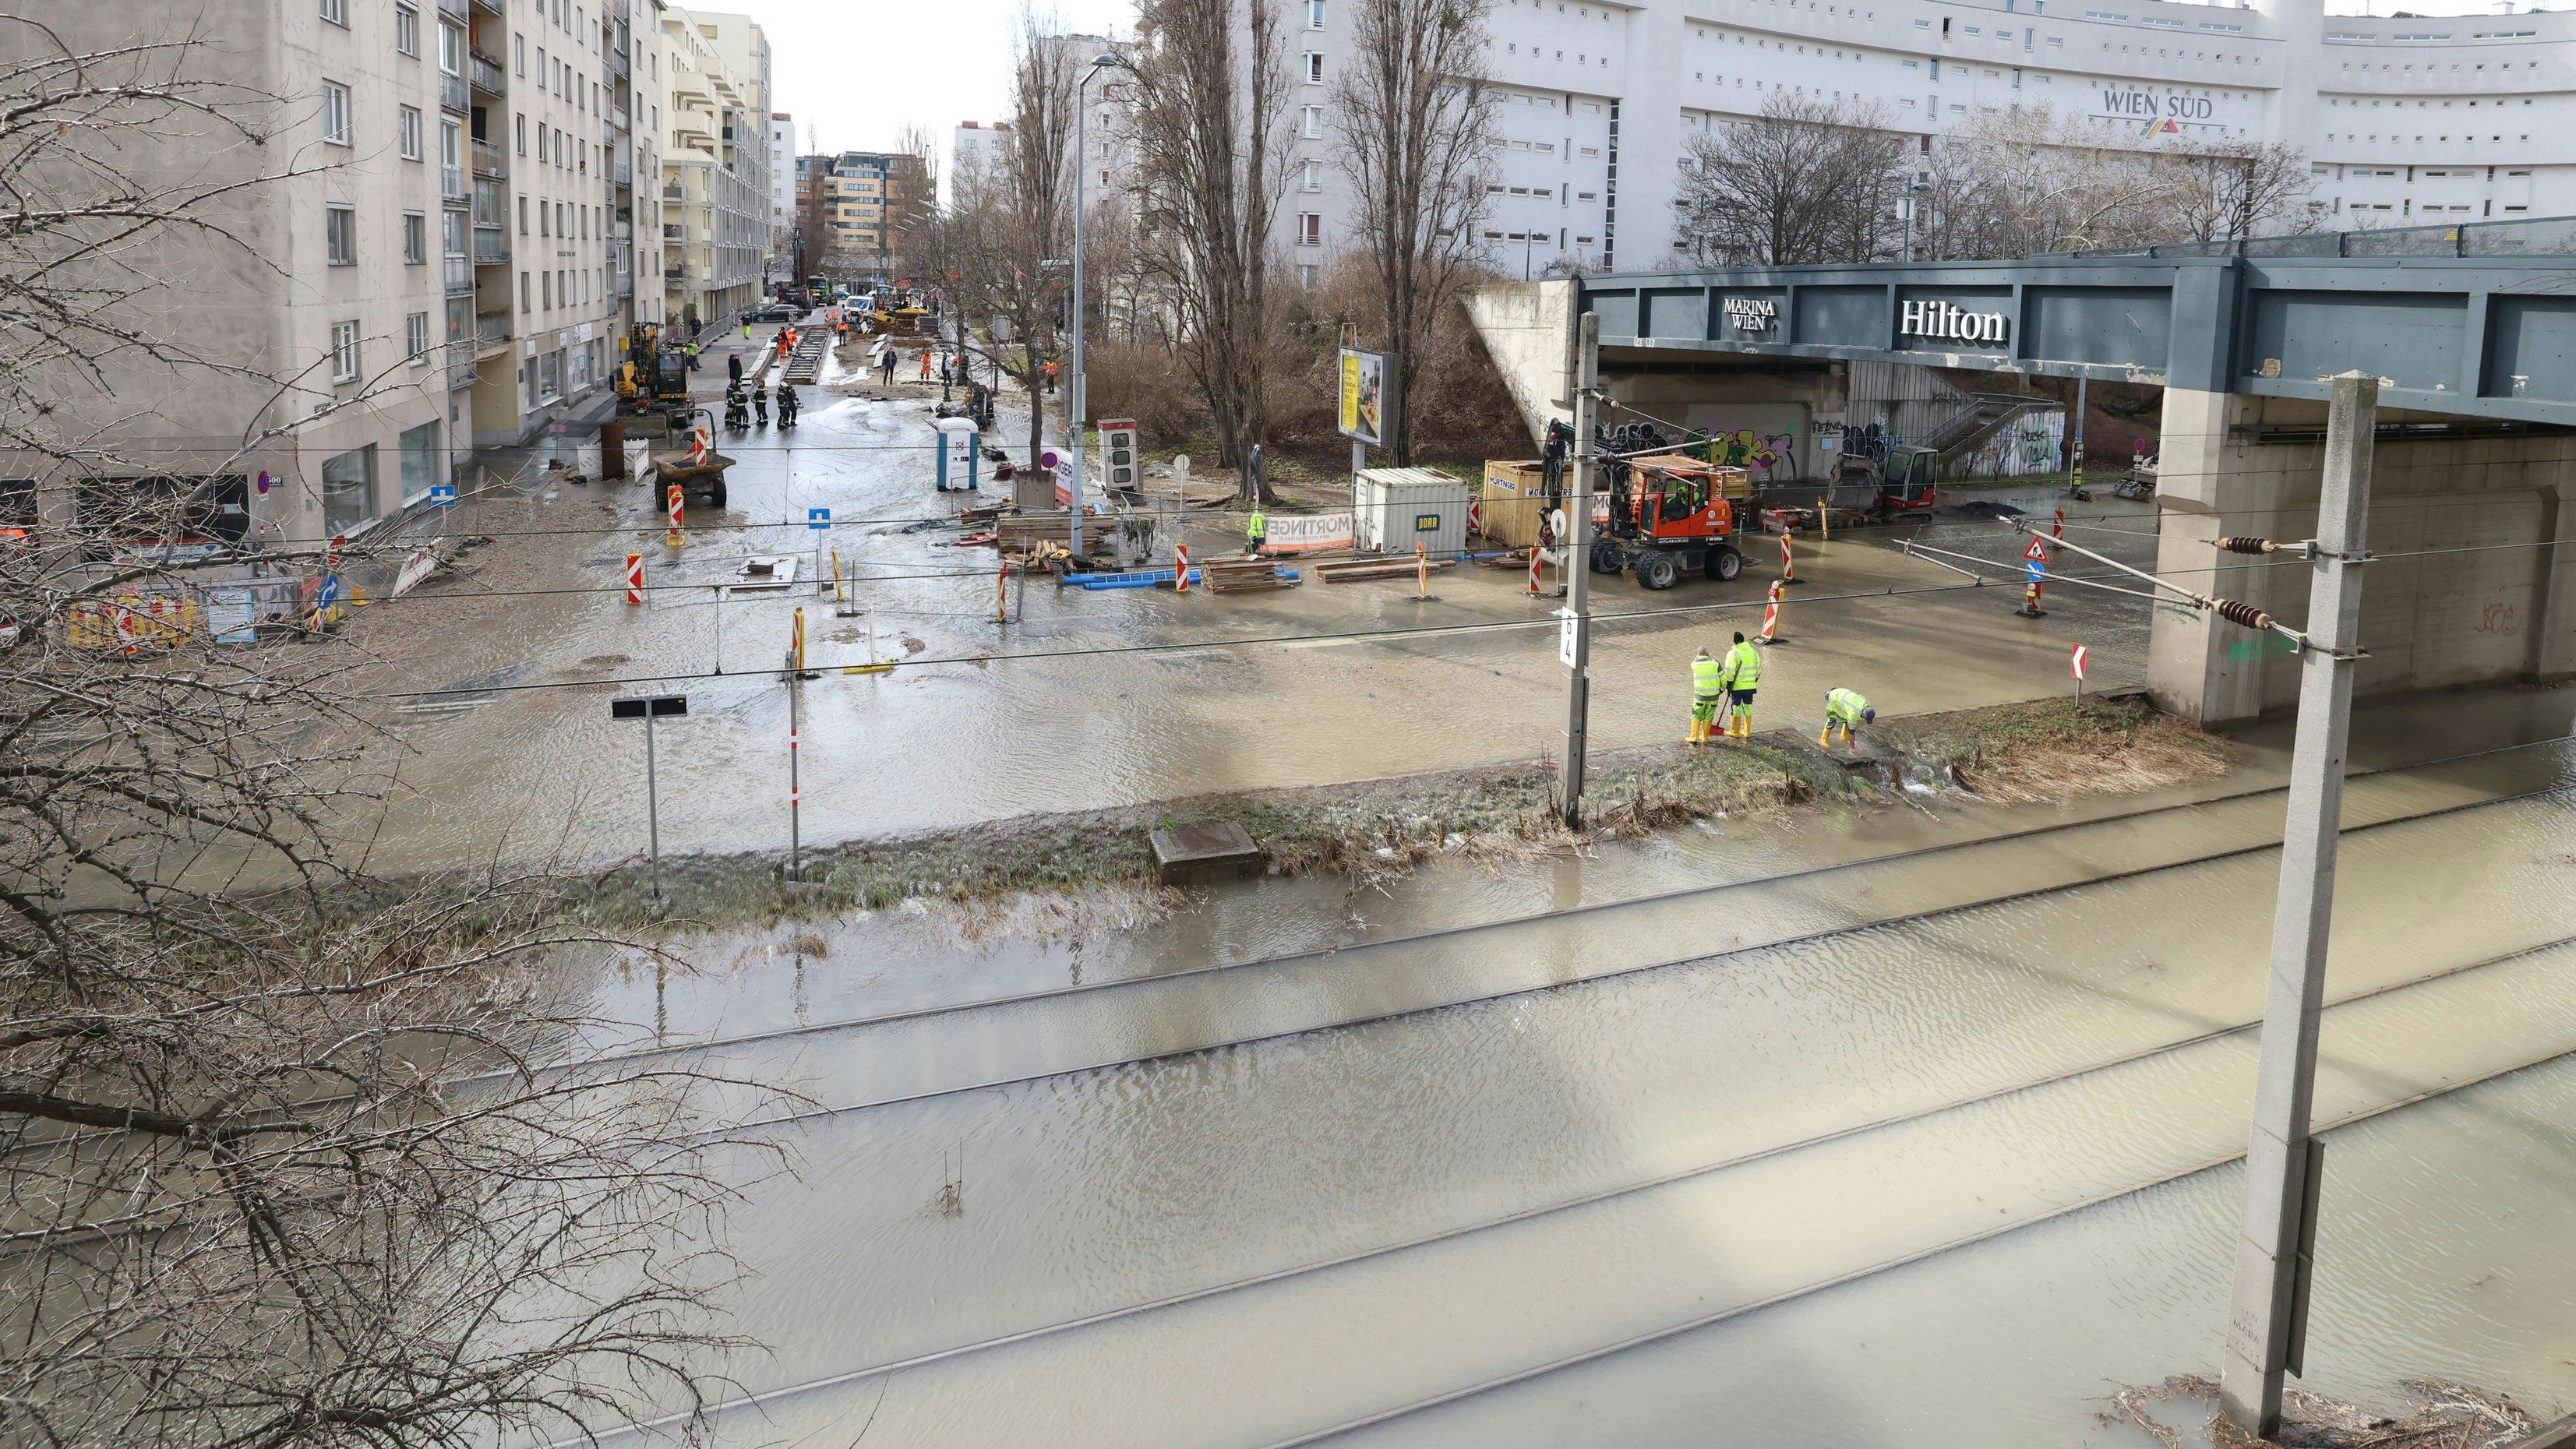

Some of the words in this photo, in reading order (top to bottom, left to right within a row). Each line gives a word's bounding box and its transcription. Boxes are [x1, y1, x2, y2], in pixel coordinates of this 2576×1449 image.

[2105, 90, 2158, 115] WIEN
[2168, 96, 2213, 118] SÜD
[1724, 298, 1775, 316] MARINA
[1731, 314, 1766, 331] WIEN
[1900, 300, 2004, 341] Hilton
